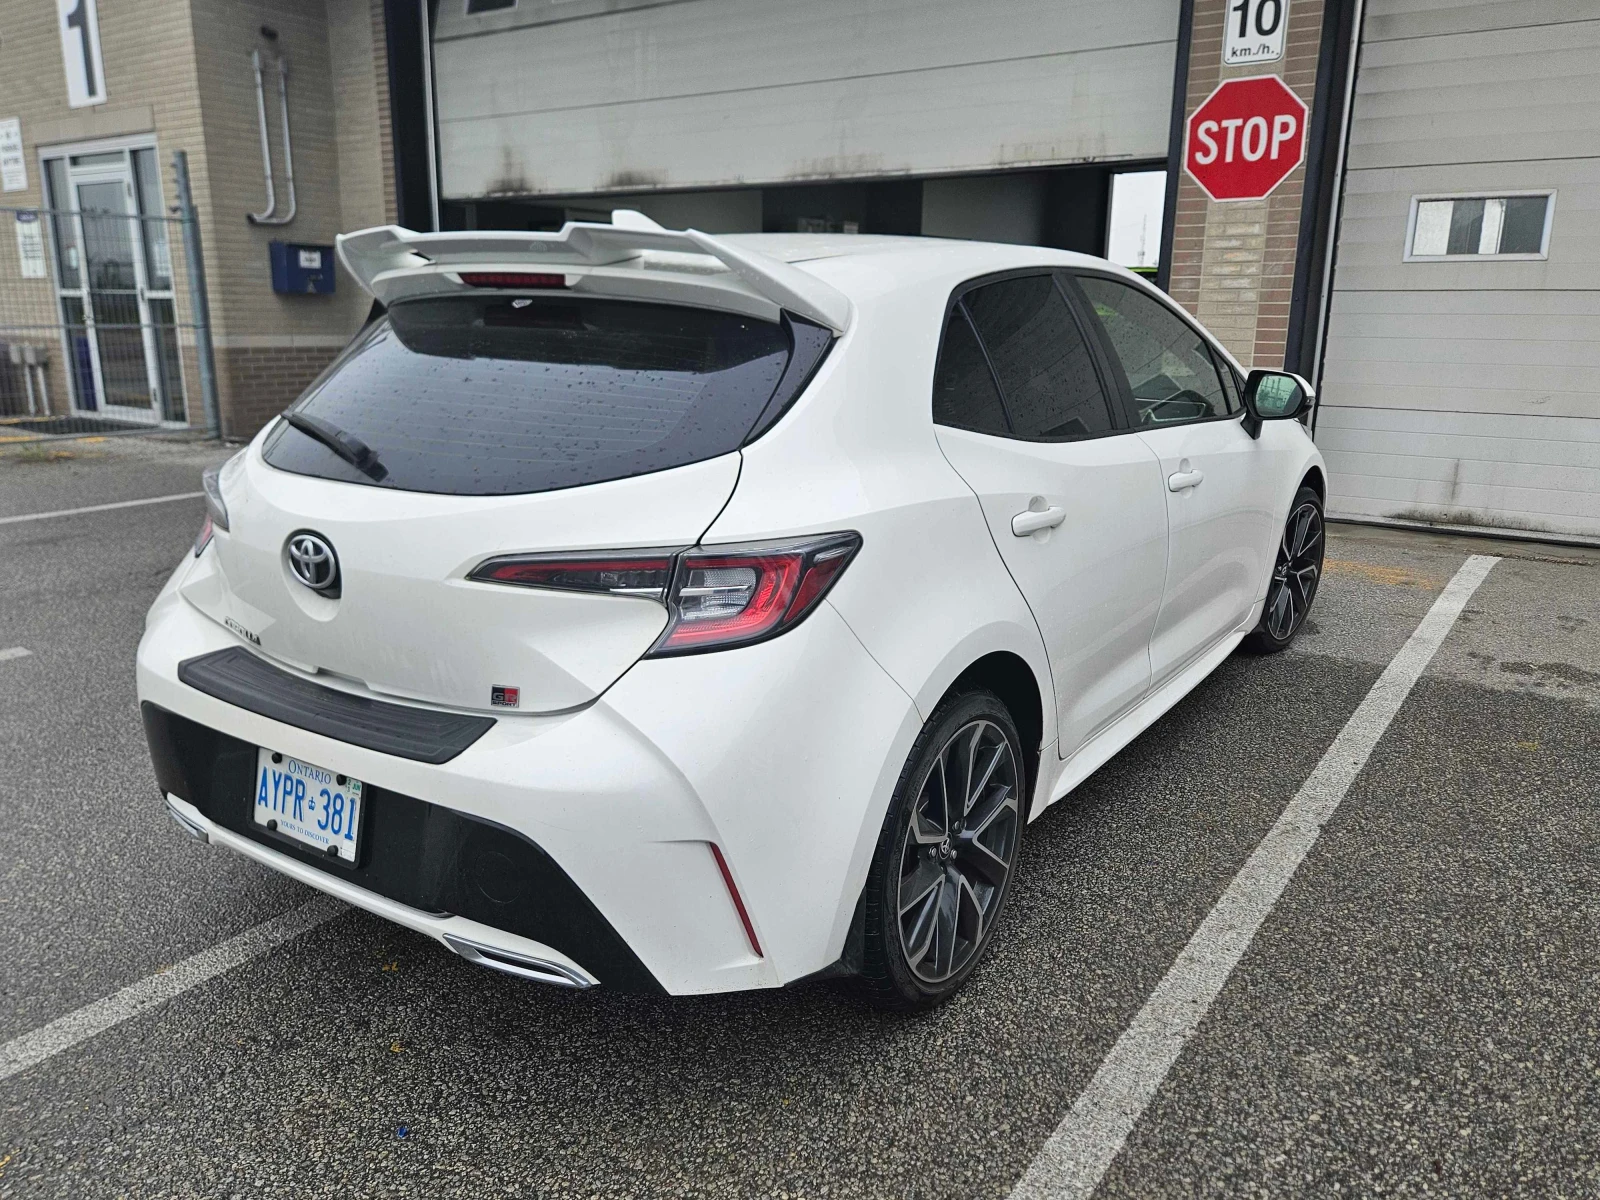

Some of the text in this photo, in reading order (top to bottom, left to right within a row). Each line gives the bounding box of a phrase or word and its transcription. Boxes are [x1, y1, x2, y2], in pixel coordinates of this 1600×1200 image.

[1233, 0, 1282, 38] 10
[67, 0, 96, 97] 1
[1195, 114, 1297, 165] STOP
[288, 759, 332, 785] ONTARIO
[258, 766, 356, 840] AYPR 381
[280, 819, 329, 844] YOURS TO DISCOVER
